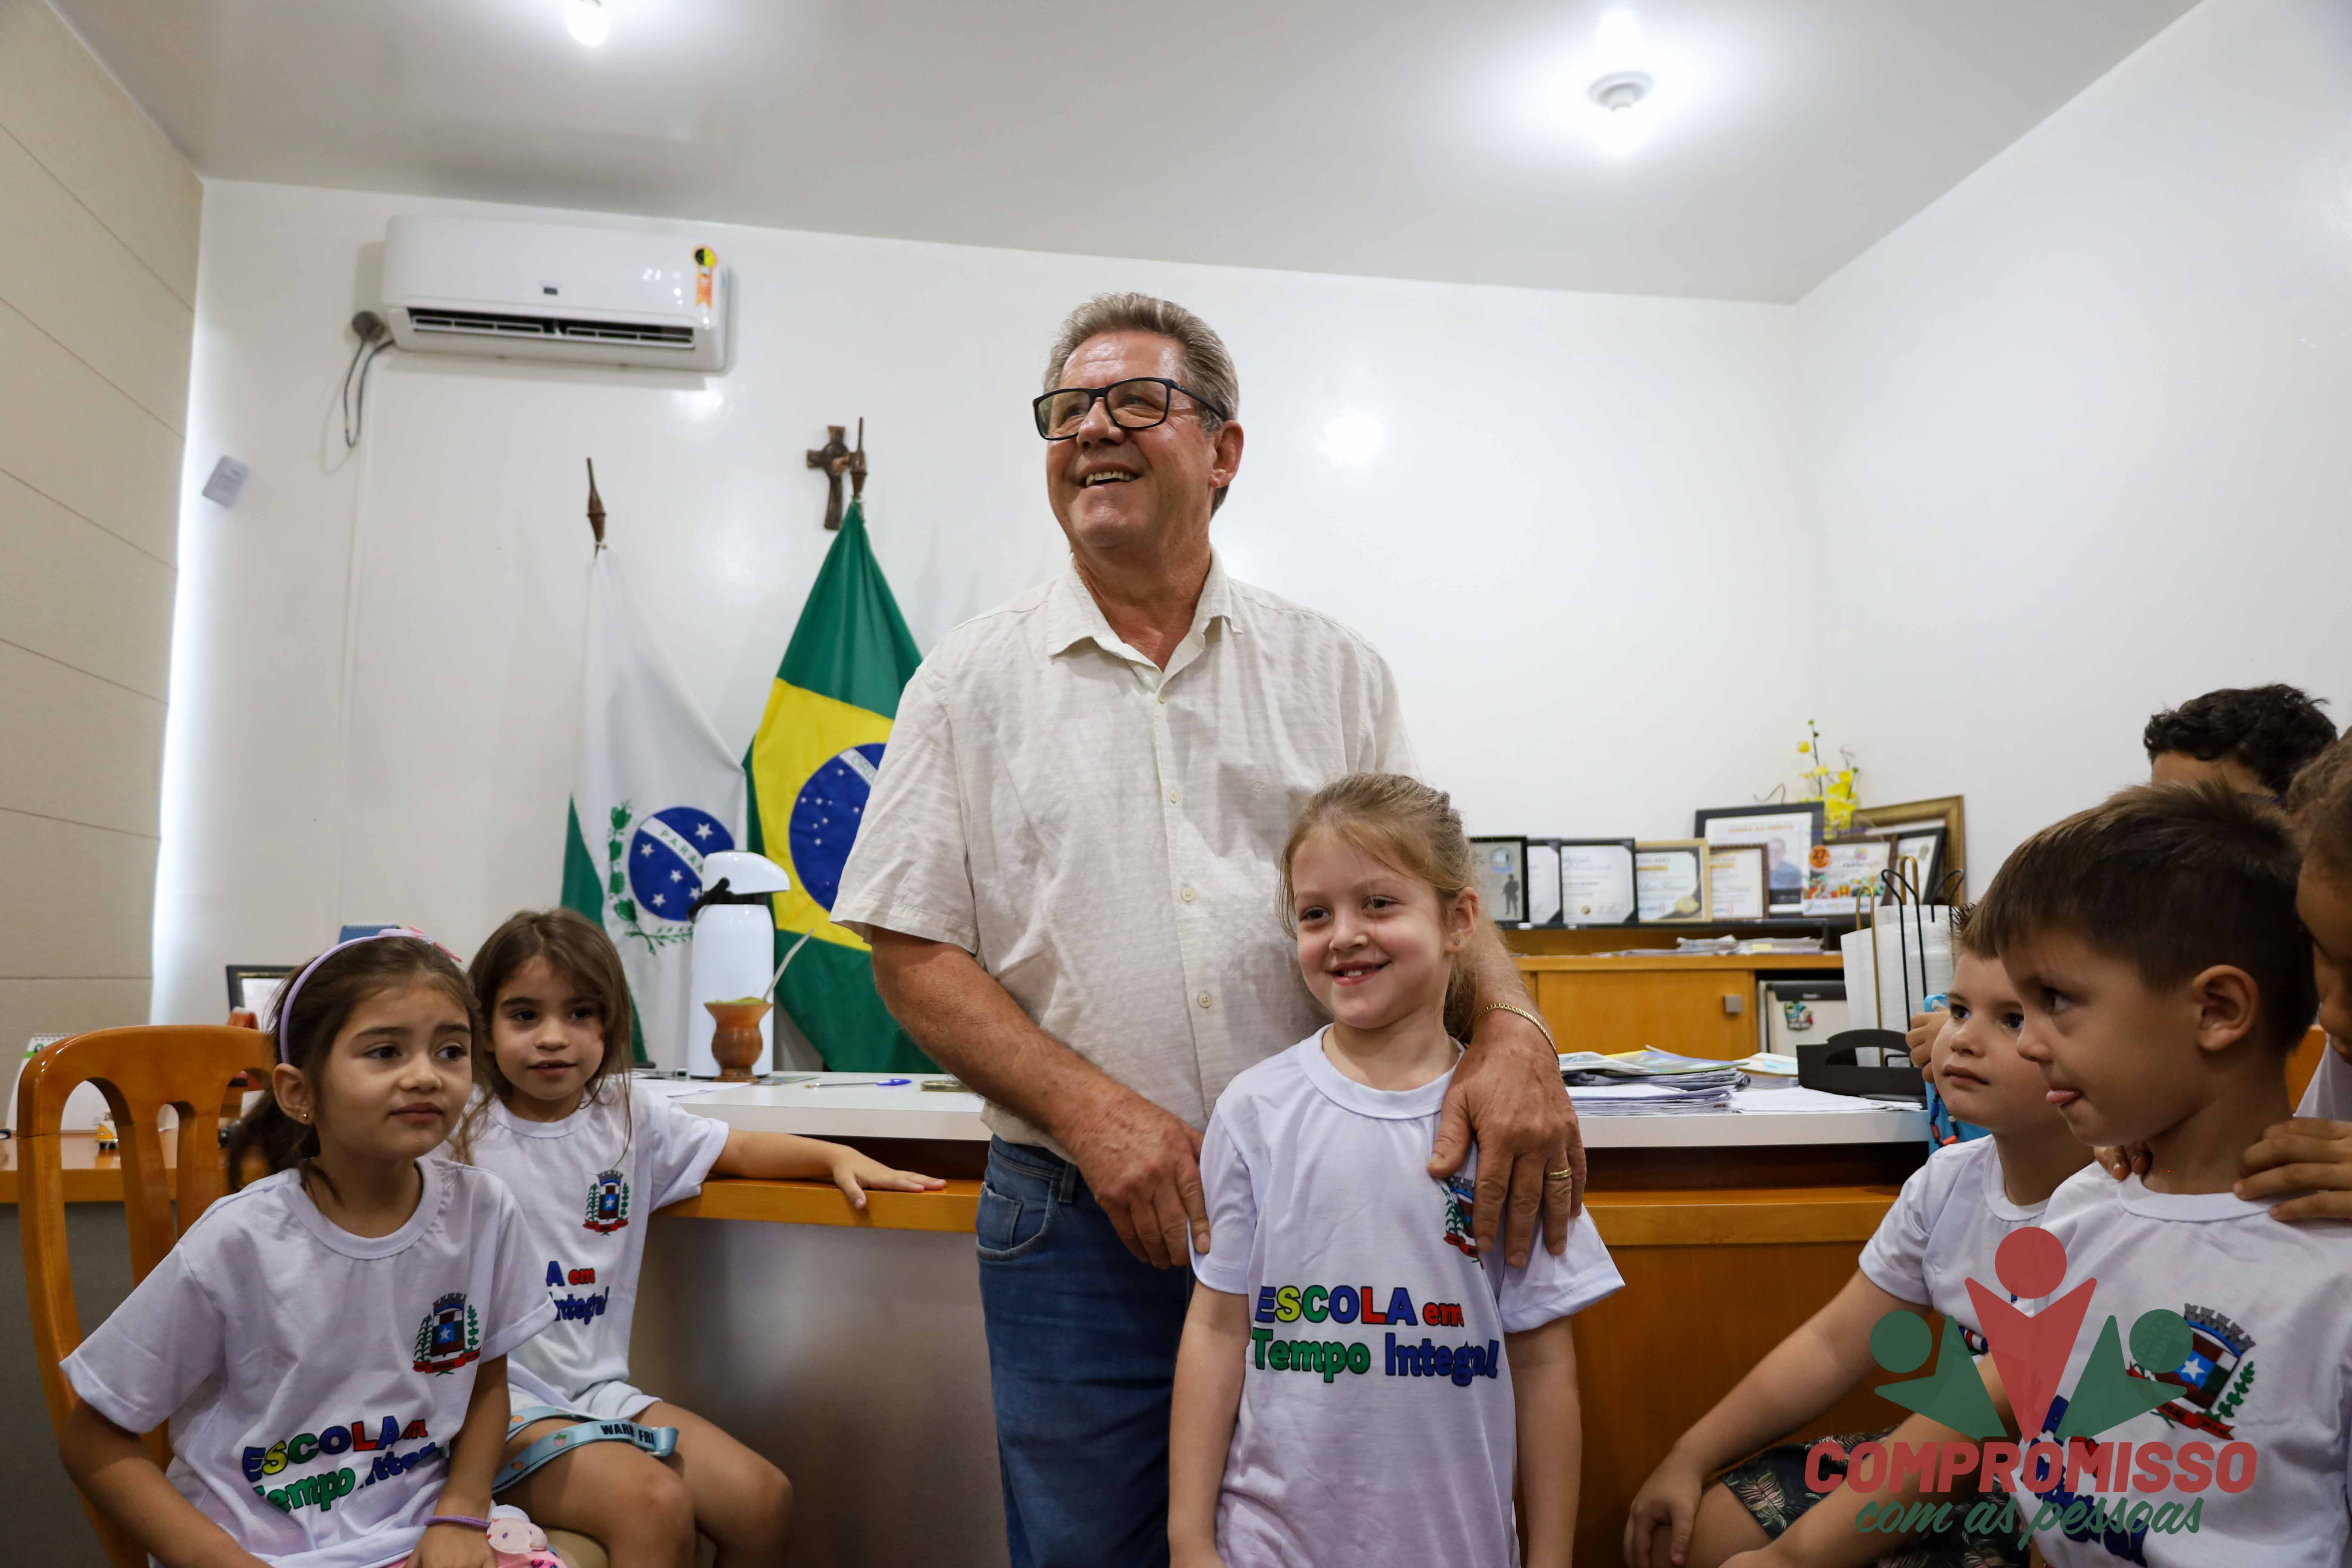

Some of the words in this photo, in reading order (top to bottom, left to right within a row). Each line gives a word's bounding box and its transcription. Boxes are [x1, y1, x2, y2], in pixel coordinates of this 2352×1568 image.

[851, 754, 877, 781] ORD
[661, 829, 703, 874] PARAN
[568, 1268, 596, 1285] em
[1255, 1285, 1418, 1326] ESCOLA
[1423, 1302, 1464, 1327] em
[1251, 1327, 1371, 1383] Tempo
[242, 1416, 400, 1482] ESCOLA
